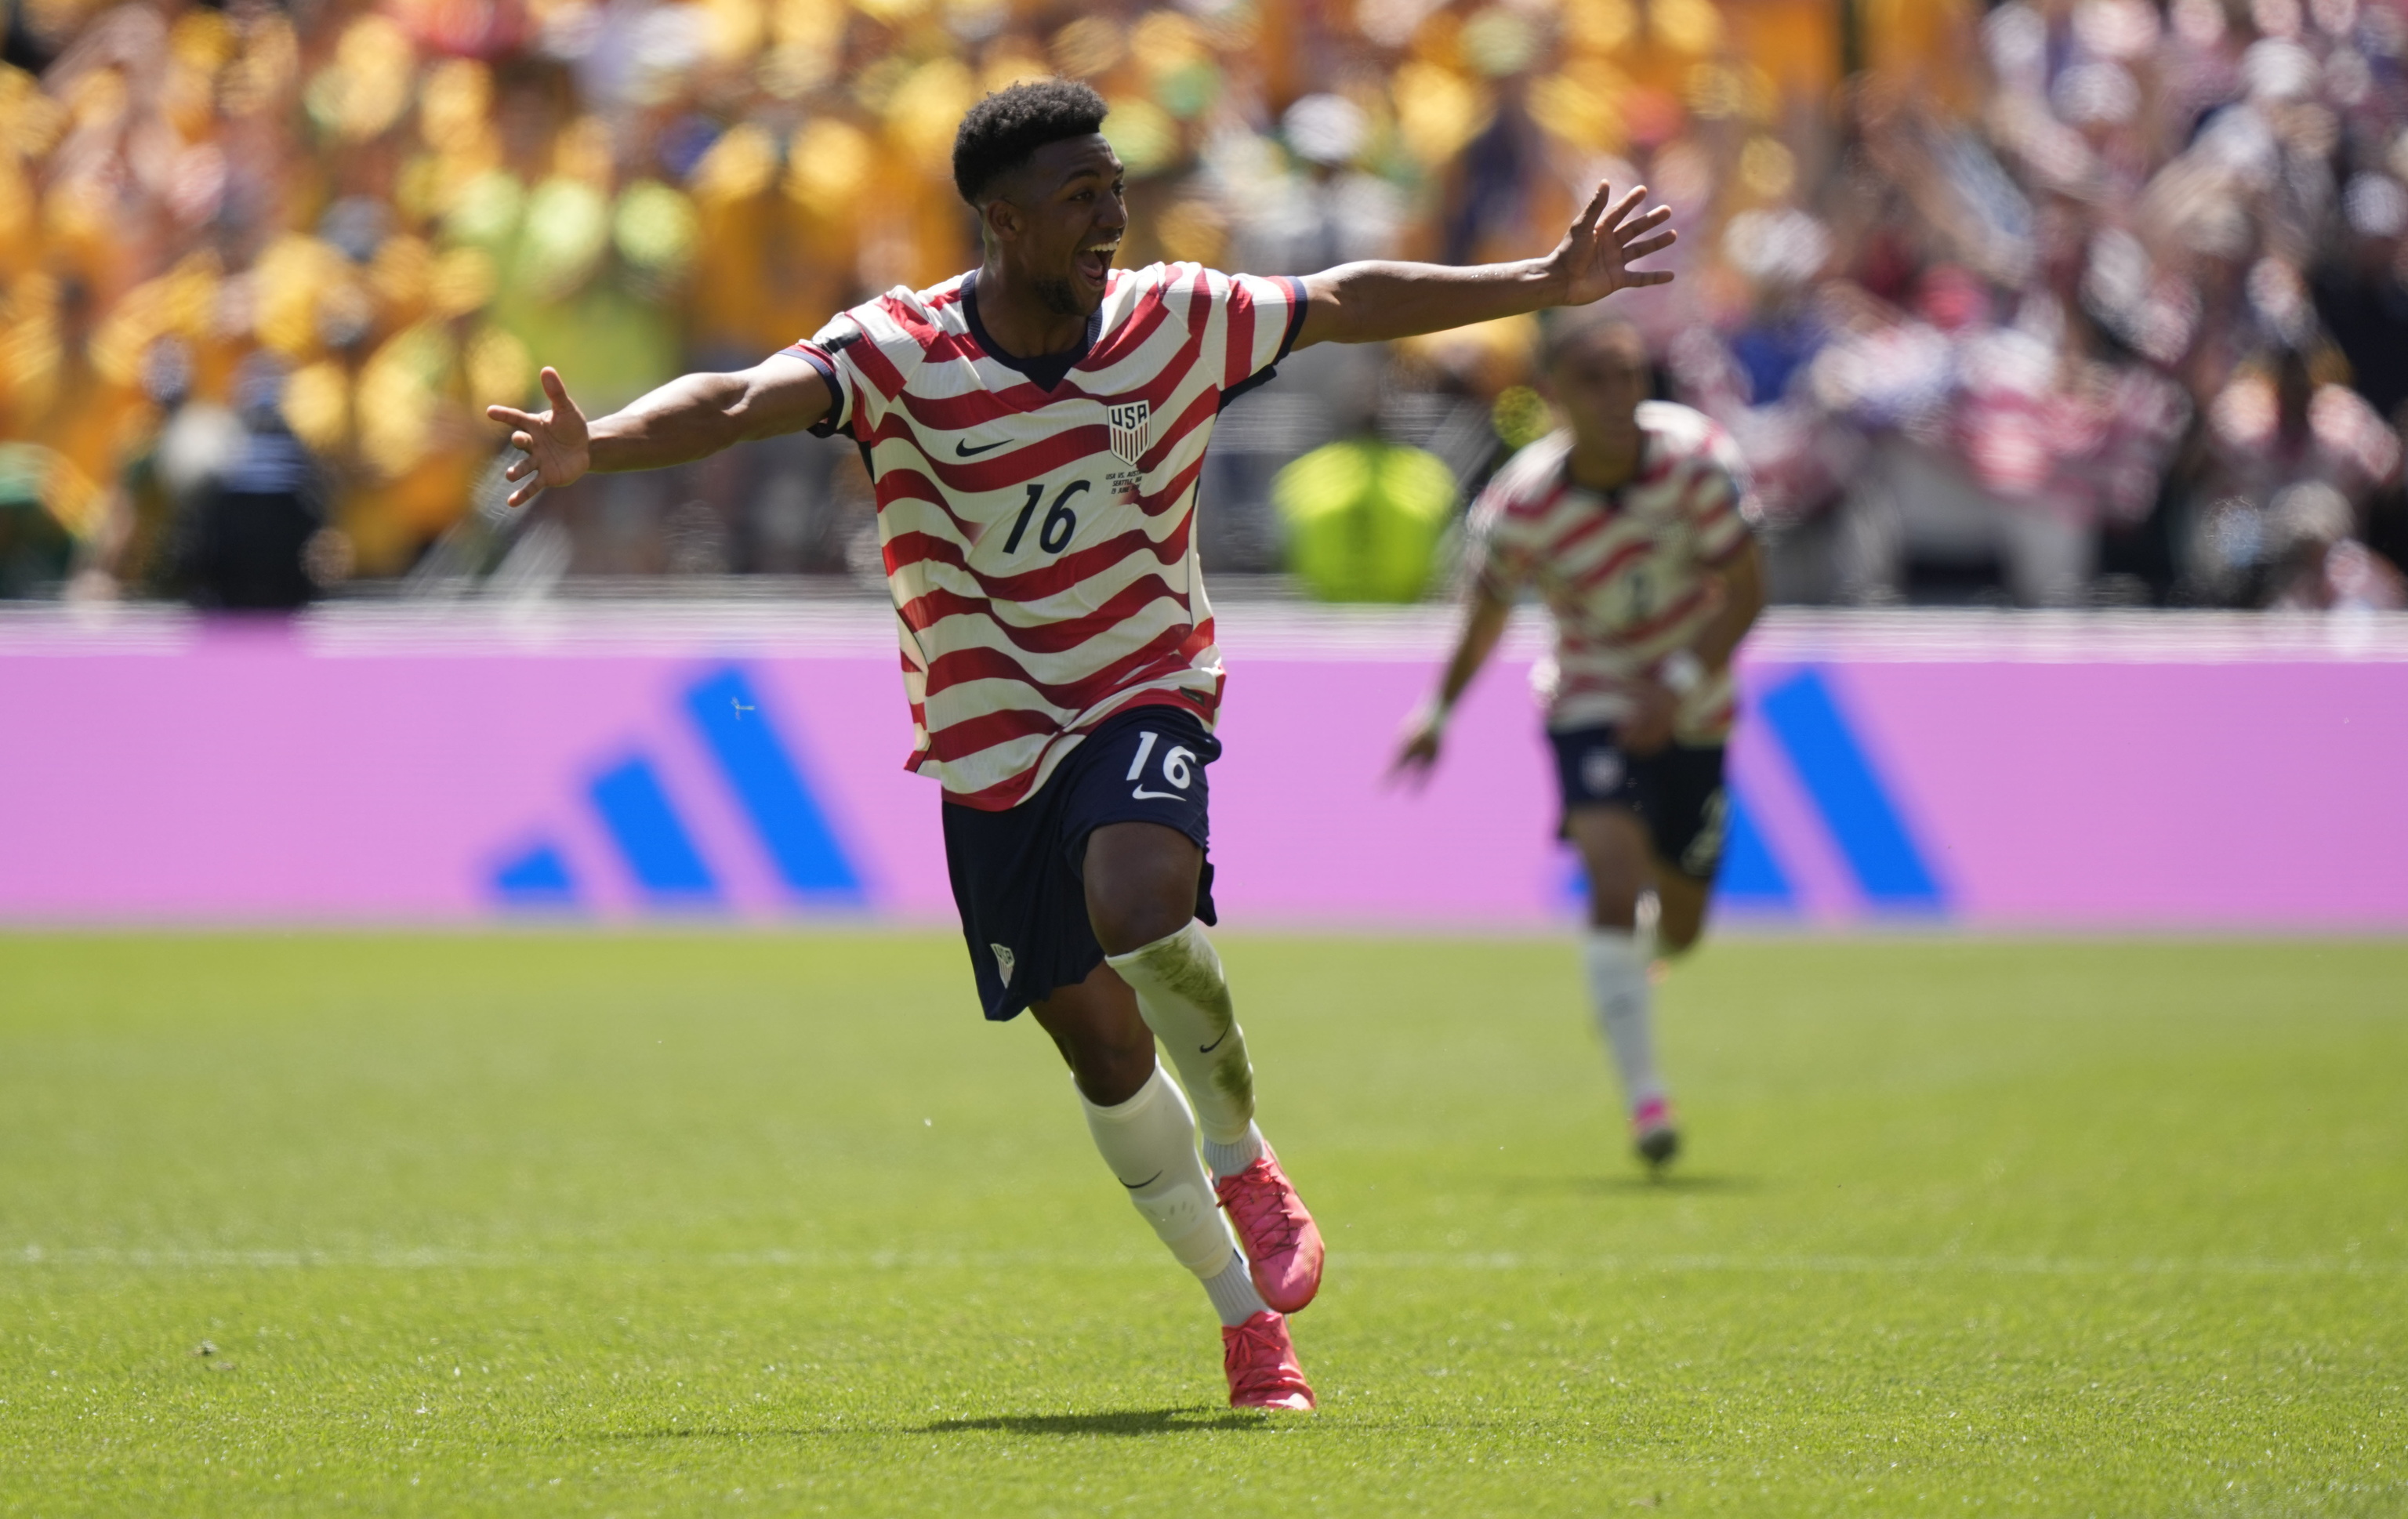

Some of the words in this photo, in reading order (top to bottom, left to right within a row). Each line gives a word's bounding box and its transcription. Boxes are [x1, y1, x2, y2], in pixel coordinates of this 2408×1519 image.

[1111, 404, 1147, 430] USA
[1003, 480, 1090, 554] 16
[1126, 730, 1196, 789] 16
